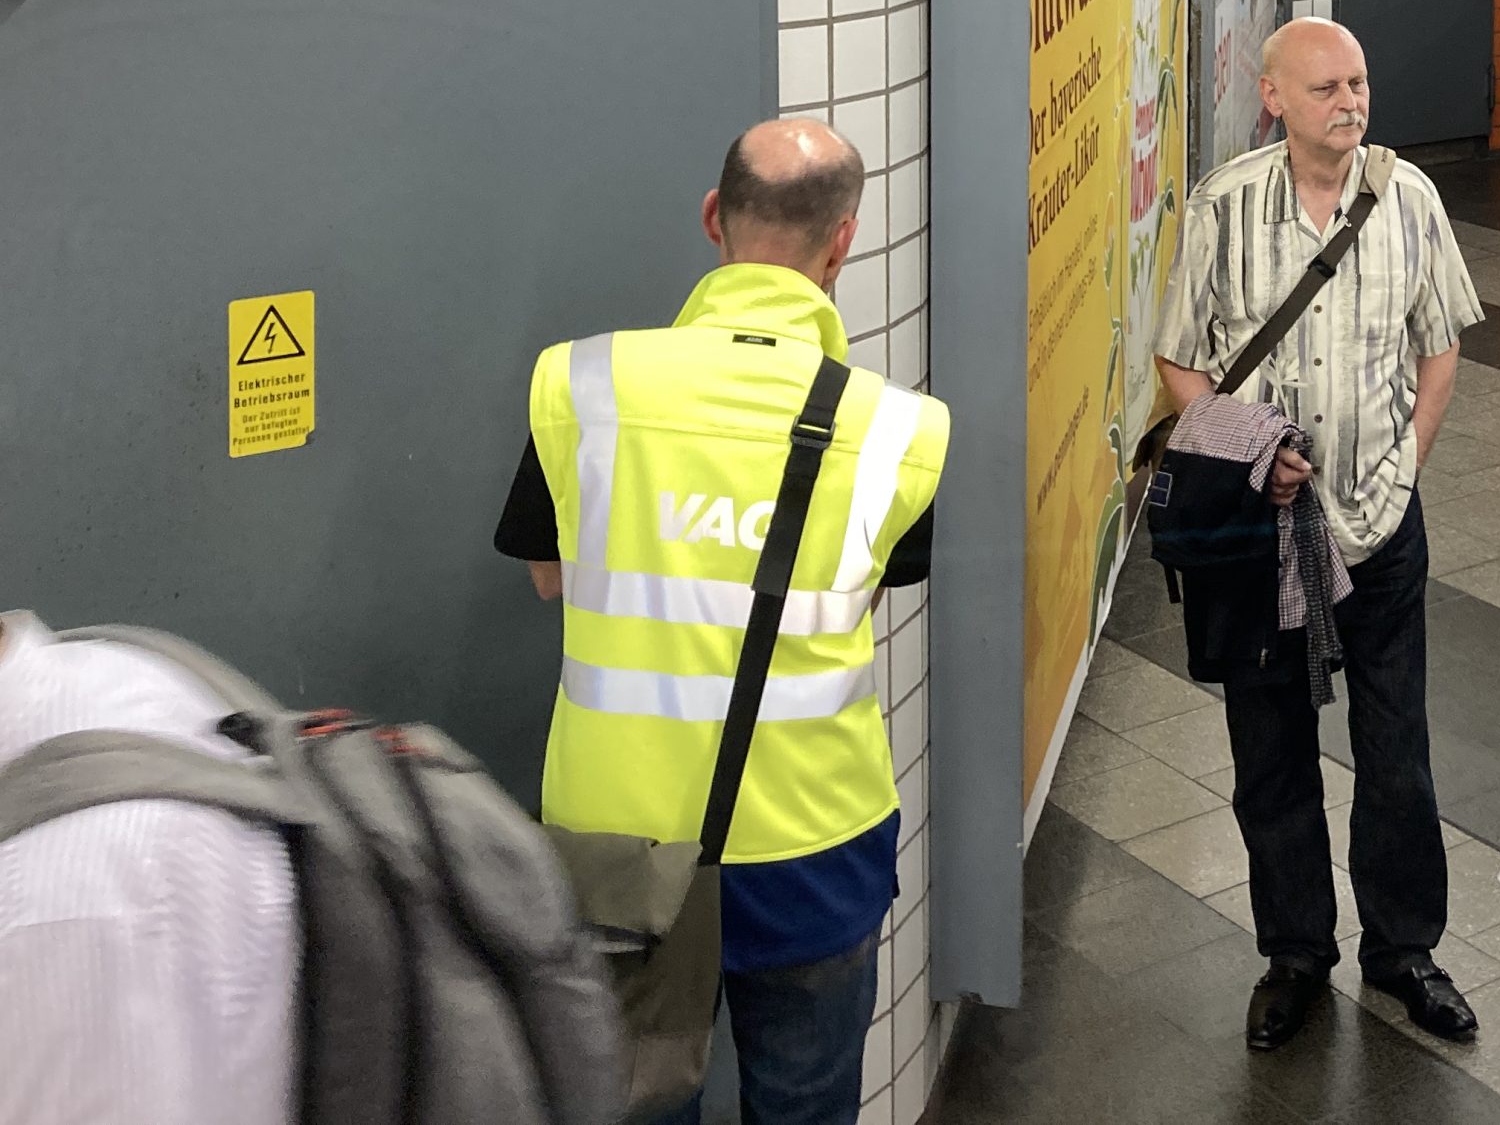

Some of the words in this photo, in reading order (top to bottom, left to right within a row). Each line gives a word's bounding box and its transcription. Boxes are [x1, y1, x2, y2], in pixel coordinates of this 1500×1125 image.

[1050, 36, 1102, 140] bayerische
[1028, 115, 1100, 256] Kräuter-Likör
[238, 374, 305, 392] Elektrischer
[234, 388, 310, 409] Betriebsraum
[242, 415, 258, 424] Der
[260, 408, 287, 421] Zutritt
[262, 419, 297, 431] befugten
[233, 434, 271, 446] Personen
